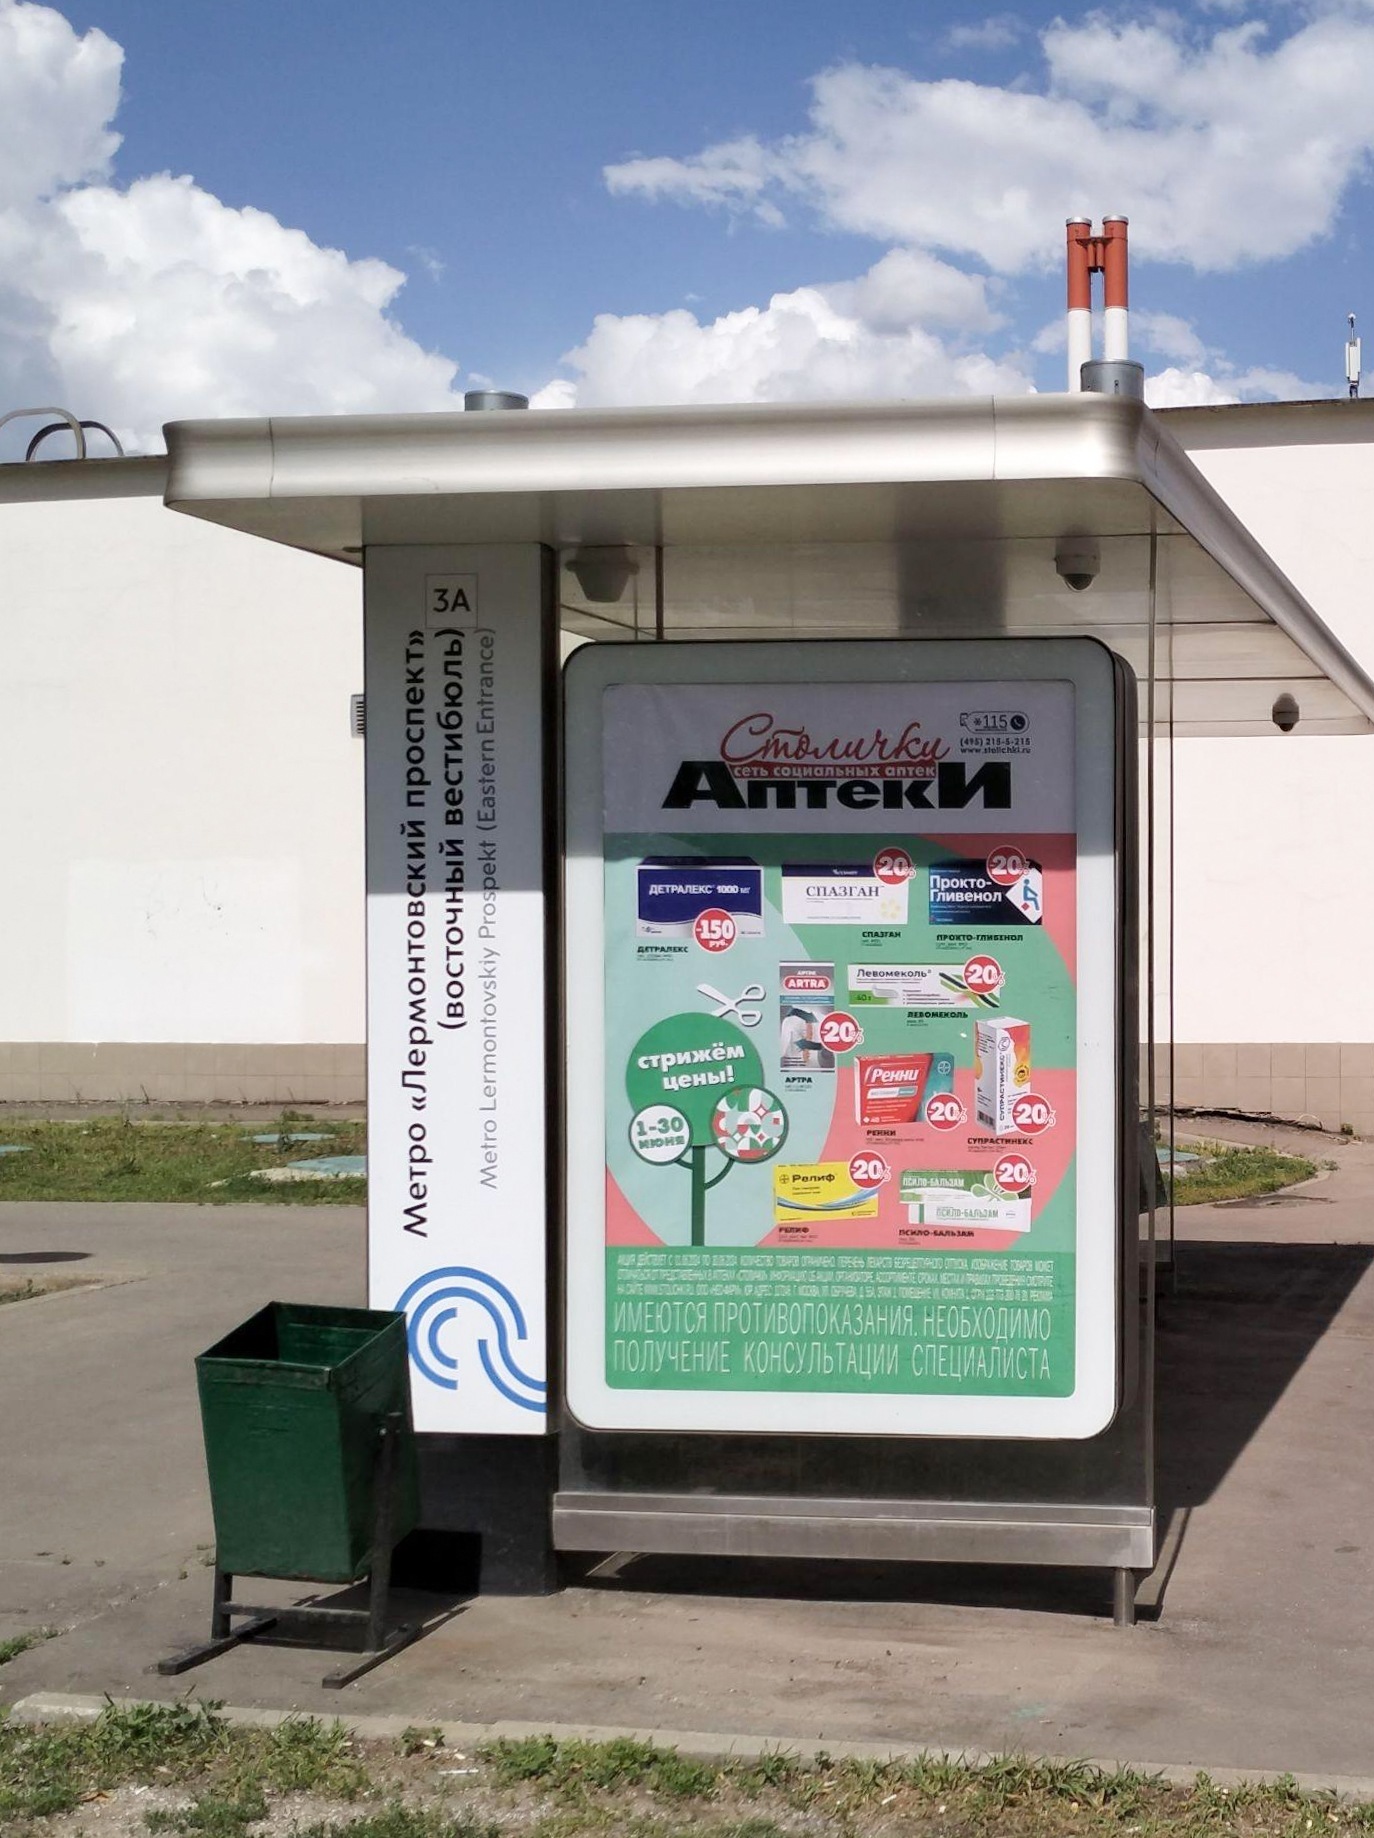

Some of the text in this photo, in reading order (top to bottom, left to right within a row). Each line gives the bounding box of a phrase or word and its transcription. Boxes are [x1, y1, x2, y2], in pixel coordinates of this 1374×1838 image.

[719, 713, 951, 763] Столички
[985, 737, 1031, 746] 215-5-215
[733, 765, 936, 780] сеть социальных аптек
[661, 760, 1012, 810] АптекИ
[434, 627, 468, 1031] (восточный вестибюль)
[877, 855, 918, 879] -20%
[991, 855, 1030, 876] -20%
[648, 883, 714, 896] ДЕТРАЛЕКС
[716, 884, 740, 895] 1000
[805, 885, 881, 898] СПАЗГАН
[930, 874, 992, 892] Прокто-
[930, 889, 1003, 903] Гливенол
[473, 627, 501, 1189] Metro Lermontovskiy Prospekt (Eastern Entrance)
[400, 629, 434, 1238] Метро «Лермонтовский проспект»
[695, 919, 736, 940] -150
[861, 930, 902, 939] СПАЗГАН
[636, 945, 689, 955] ДЕТРАЛЕКС
[856, 968, 928, 979] Левомеколь
[964, 964, 1007, 987] -20%
[787, 977, 827, 990] ARTRA
[906, 1010, 969, 1020] ЛЕВОМЕКОЛЬ
[820, 1021, 865, 1044] -20%
[637, 1042, 746, 1072] стрижём
[662, 1064, 735, 1092] цены!
[785, 1076, 813, 1084] АРТРА
[871, 1067, 919, 1083] Ренни
[927, 1101, 968, 1123] -20%
[1013, 1103, 1057, 1127] -20%
[636, 1116, 684, 1137] 1-30
[638, 1135, 686, 1150] ИЮНЯ
[966, 1137, 1033, 1146] СУПРАСТИНЕКС
[791, 1173, 836, 1184] Релиф
[850, 1159, 892, 1181] -20%
[996, 1162, 1038, 1185] -20%
[902, 1176, 965, 1188] ПСИЛО-БАЛЬЗАМ
[935, 1207, 999, 1219] ПСИЛО-БАЛЬЗАМ
[898, 1229, 976, 1238] ПСИЛО-БАЛЬЗАМ
[613, 1301, 1052, 1344] ИМЕЮТСЯ ПРОТИВОПОКАЗАНИЯ. НЕОБХОДИМО
[613, 1339, 1052, 1382] ПОЛУЧЕНИЕ КОНСУЛЬТАЦИИ СПЕЦИАЛИСТА
